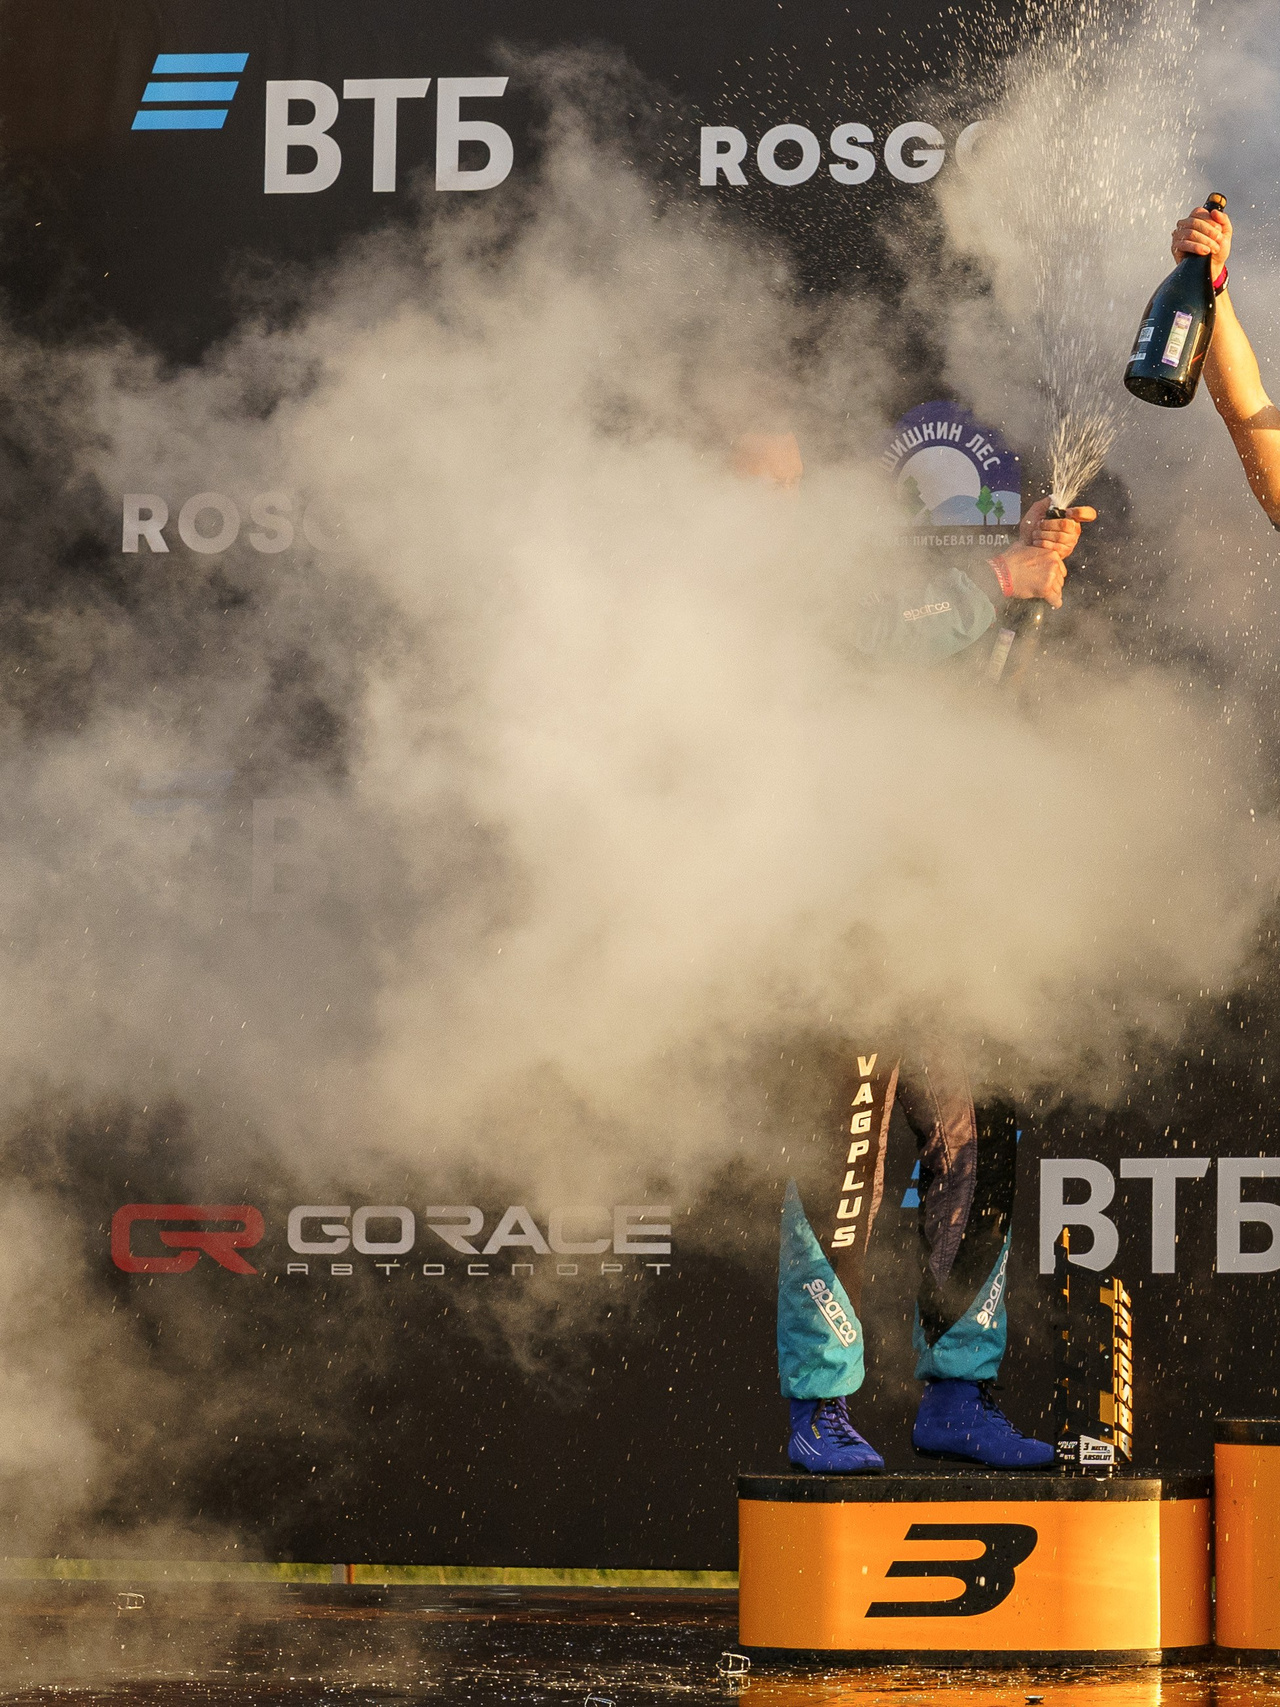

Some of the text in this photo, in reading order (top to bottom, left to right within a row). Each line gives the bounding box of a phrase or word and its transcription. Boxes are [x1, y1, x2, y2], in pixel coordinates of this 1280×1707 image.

[264, 77, 514, 194] ВТБ
[881, 420, 1001, 473] ШИШКИН ЛЕС
[913, 533, 974, 547] ПИТЬЕВАЯ
[978, 533, 1011, 547] ВОДА
[830, 1053, 878, 1249] VAGPLUS
[287, 1262, 672, 1276] АВТОСПОРТ
[804, 1277, 858, 1347] sparco
[1083, 1442, 1091, 1451] 3
[864, 1523, 1039, 1617] 3
